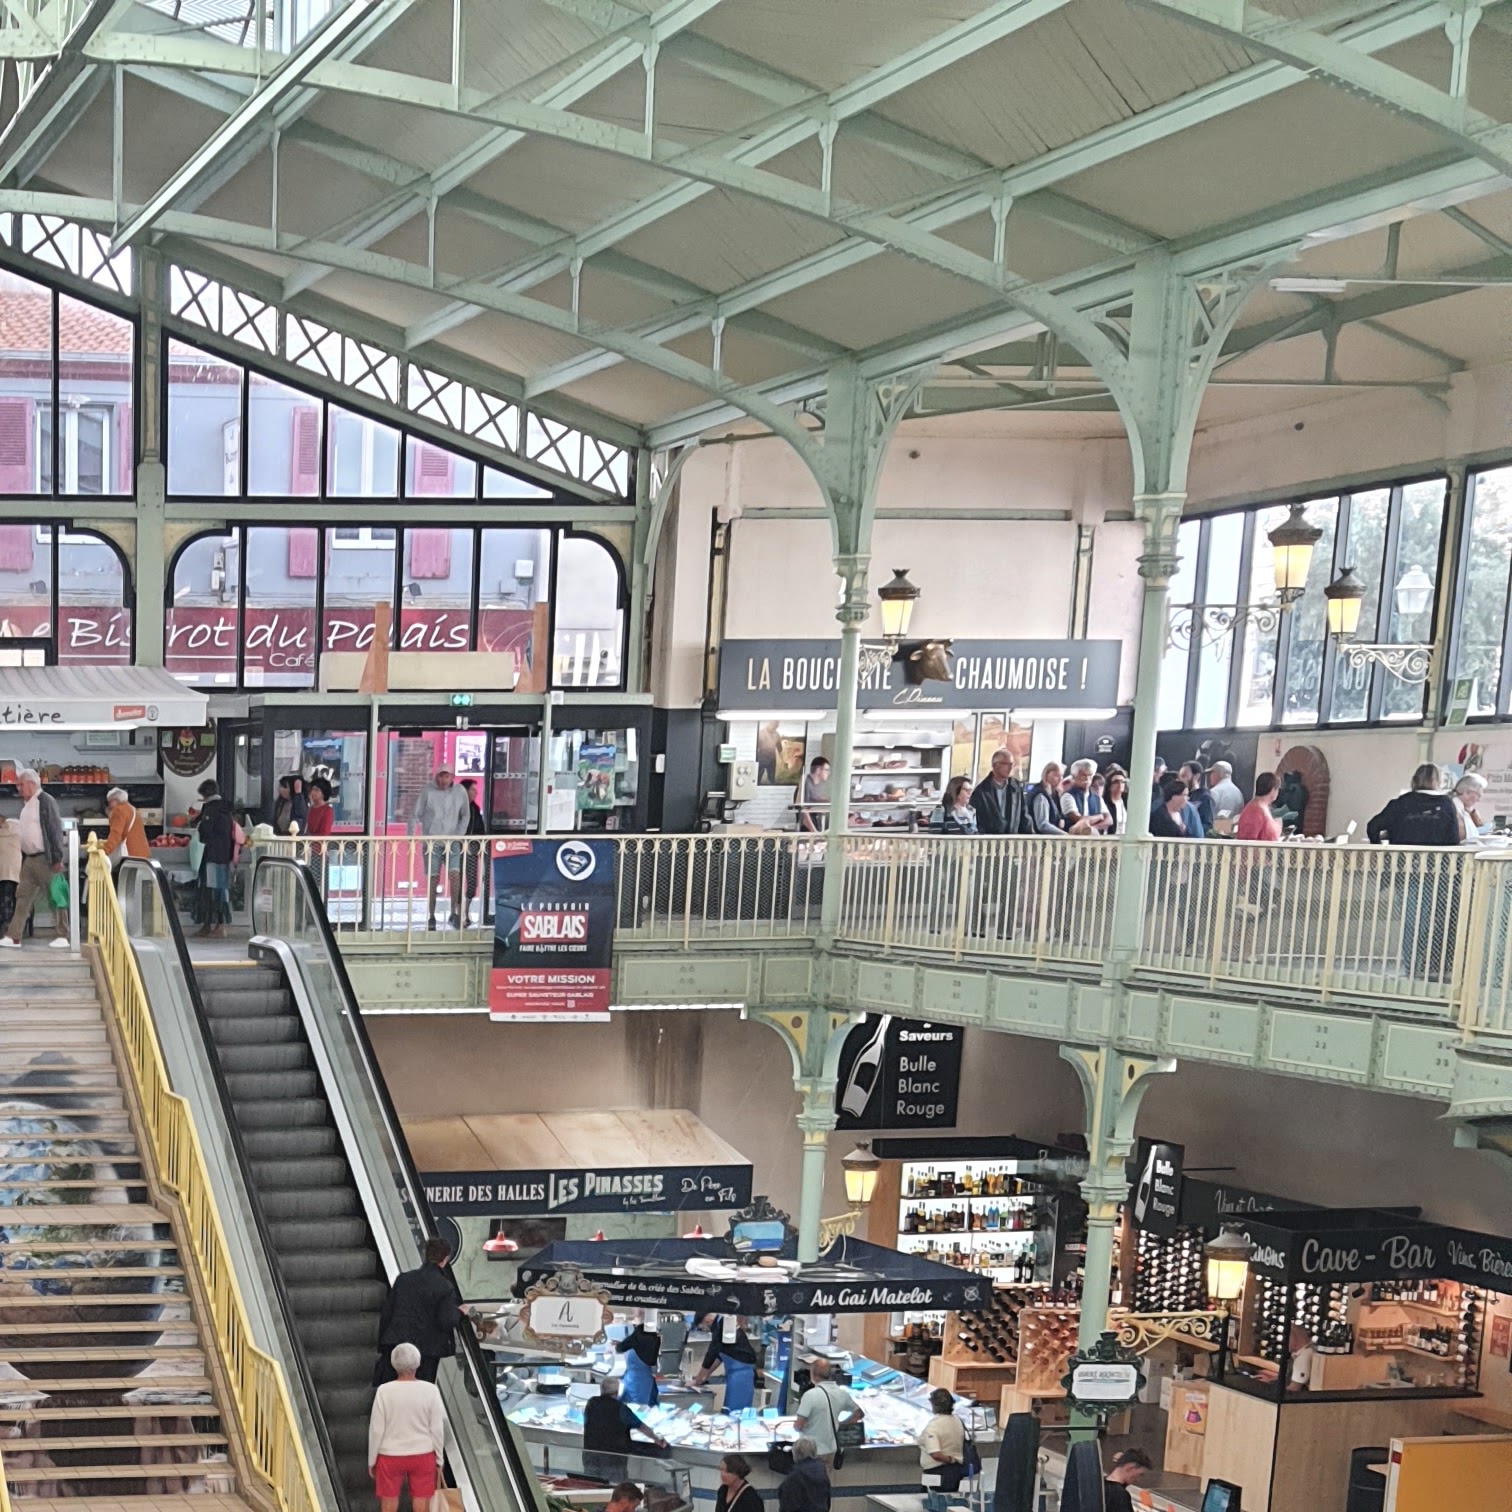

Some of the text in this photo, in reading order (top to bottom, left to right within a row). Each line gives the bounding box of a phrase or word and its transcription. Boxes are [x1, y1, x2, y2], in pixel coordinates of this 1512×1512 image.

[246, 614, 306, 649] du
[747, 657, 771, 691] LA
[955, 656, 1070, 690] CHAUMOISE
[521, 902, 590, 912] LE POUVOIR
[524, 914, 586, 939] SABLAIS
[507, 974, 596, 984] VOTRE MISSION
[899, 1030, 954, 1042] Saveurs
[899, 1055, 937, 1072] Bulle
[898, 1077, 941, 1094] Blanc
[896, 1099, 945, 1119] Rouge
[468, 1184, 492, 1202] DES
[498, 1183, 545, 1201] HALLES
[547, 1173, 579, 1210] LES
[584, 1171, 664, 1196] PINASSES
[1302, 1239, 1362, 1273] Cave
[1381, 1235, 1437, 1270] Bar
[810, 1286, 934, 1307] Au Gai Matelot
